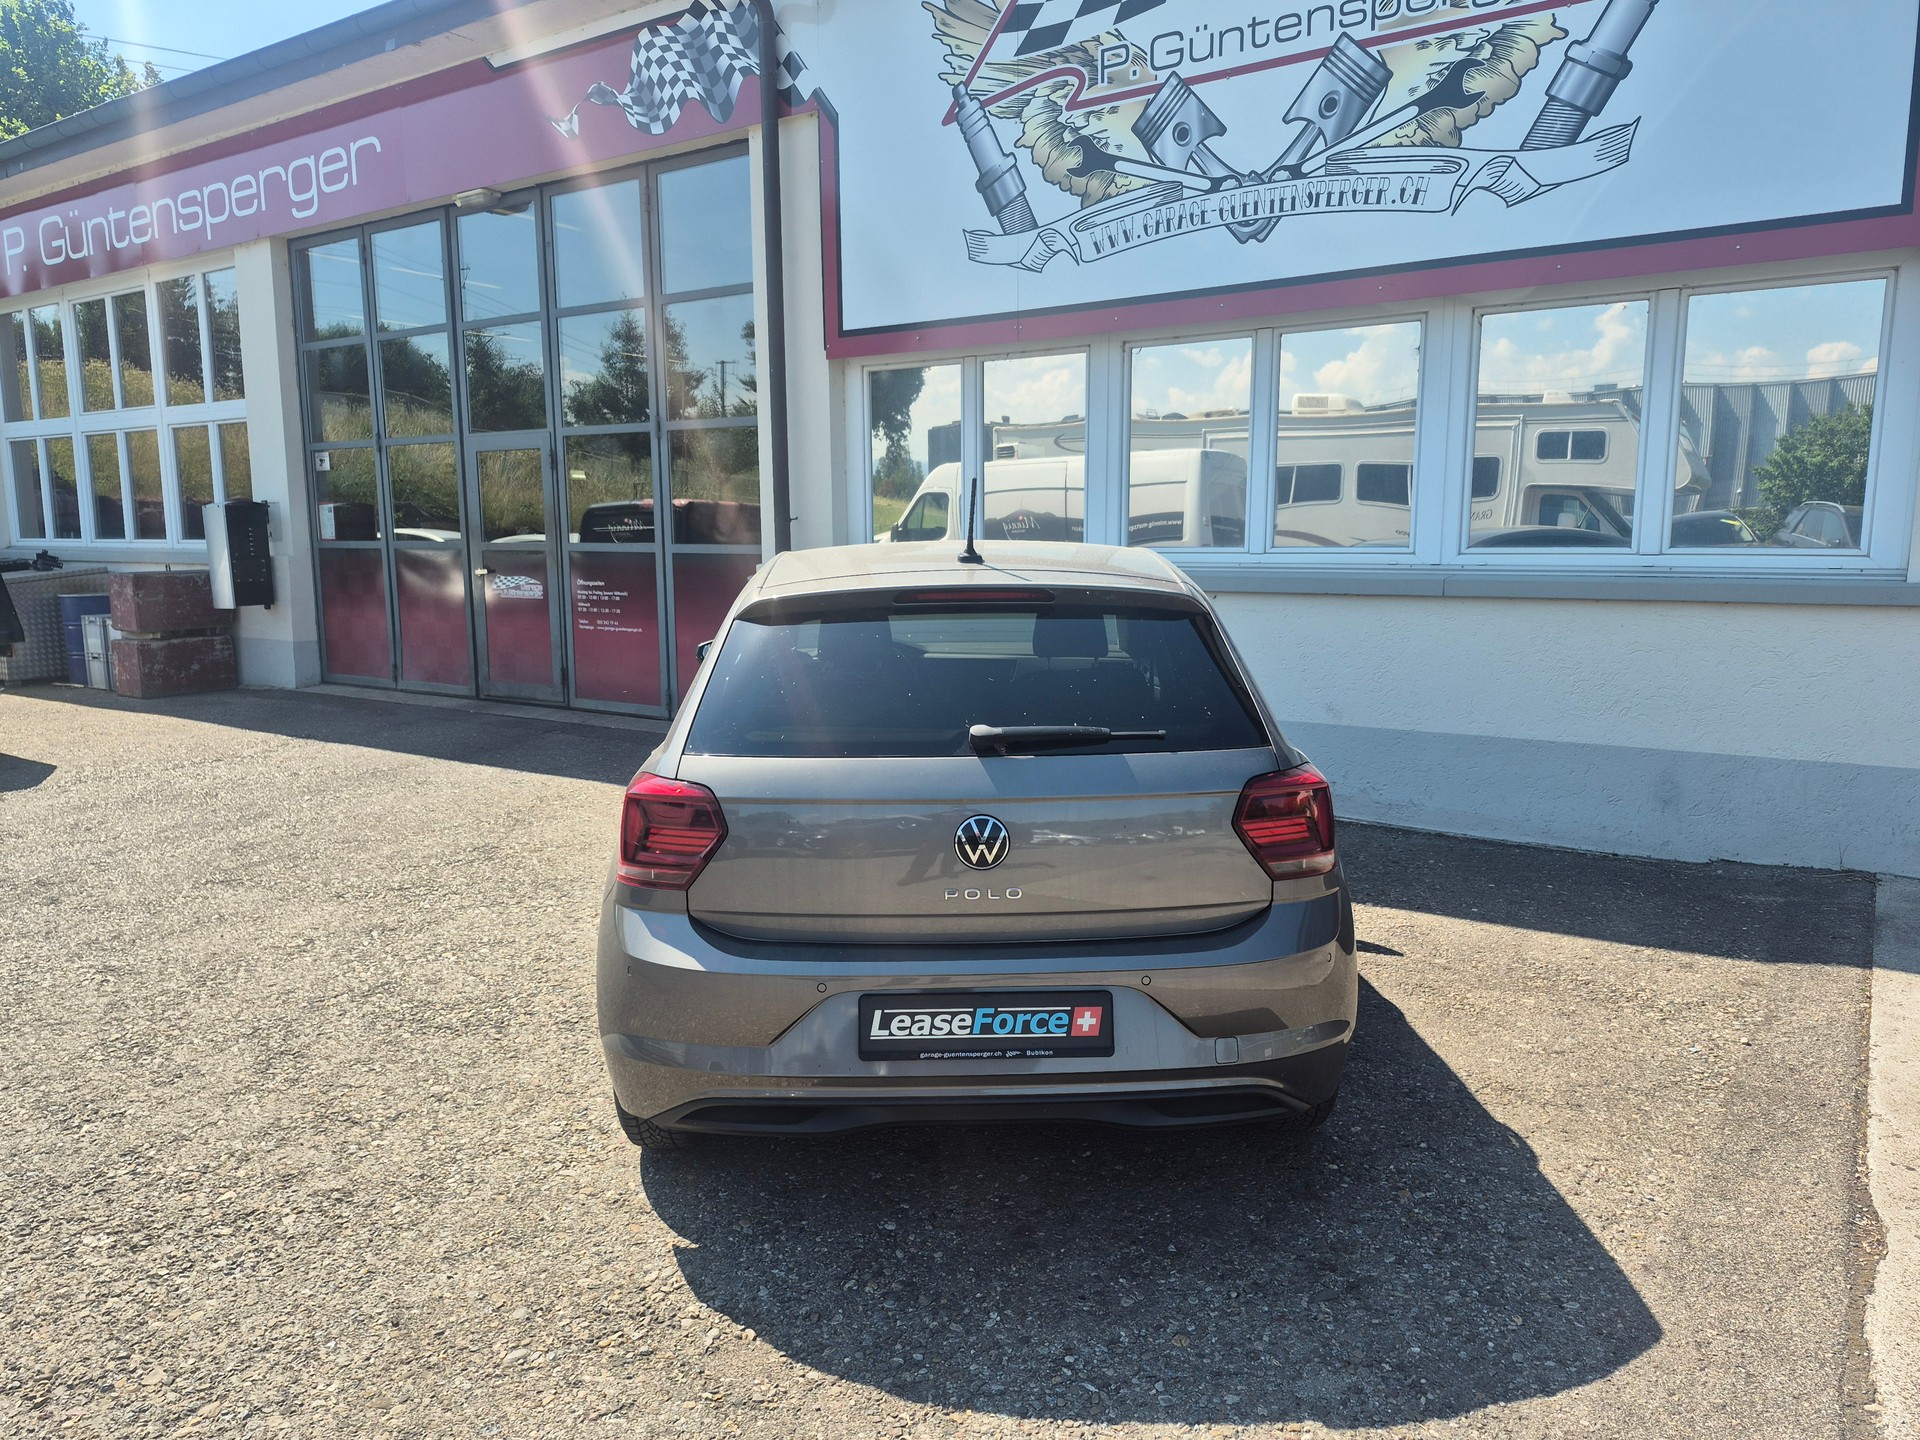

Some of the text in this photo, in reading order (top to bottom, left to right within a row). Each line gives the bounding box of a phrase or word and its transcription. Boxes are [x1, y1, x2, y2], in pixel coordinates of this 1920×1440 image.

[1099, 42, 1138, 84] P.
[2, 136, 382, 275] P. Güntensperger
[1089, 175, 1433, 255] WWW.GARAGE-GUENTENSPERGER.CH
[944, 887, 1023, 901] POLO
[870, 1008, 1070, 1036] LeaseForce
[919, 1050, 1003, 1059] garage-guentensperger.ch
